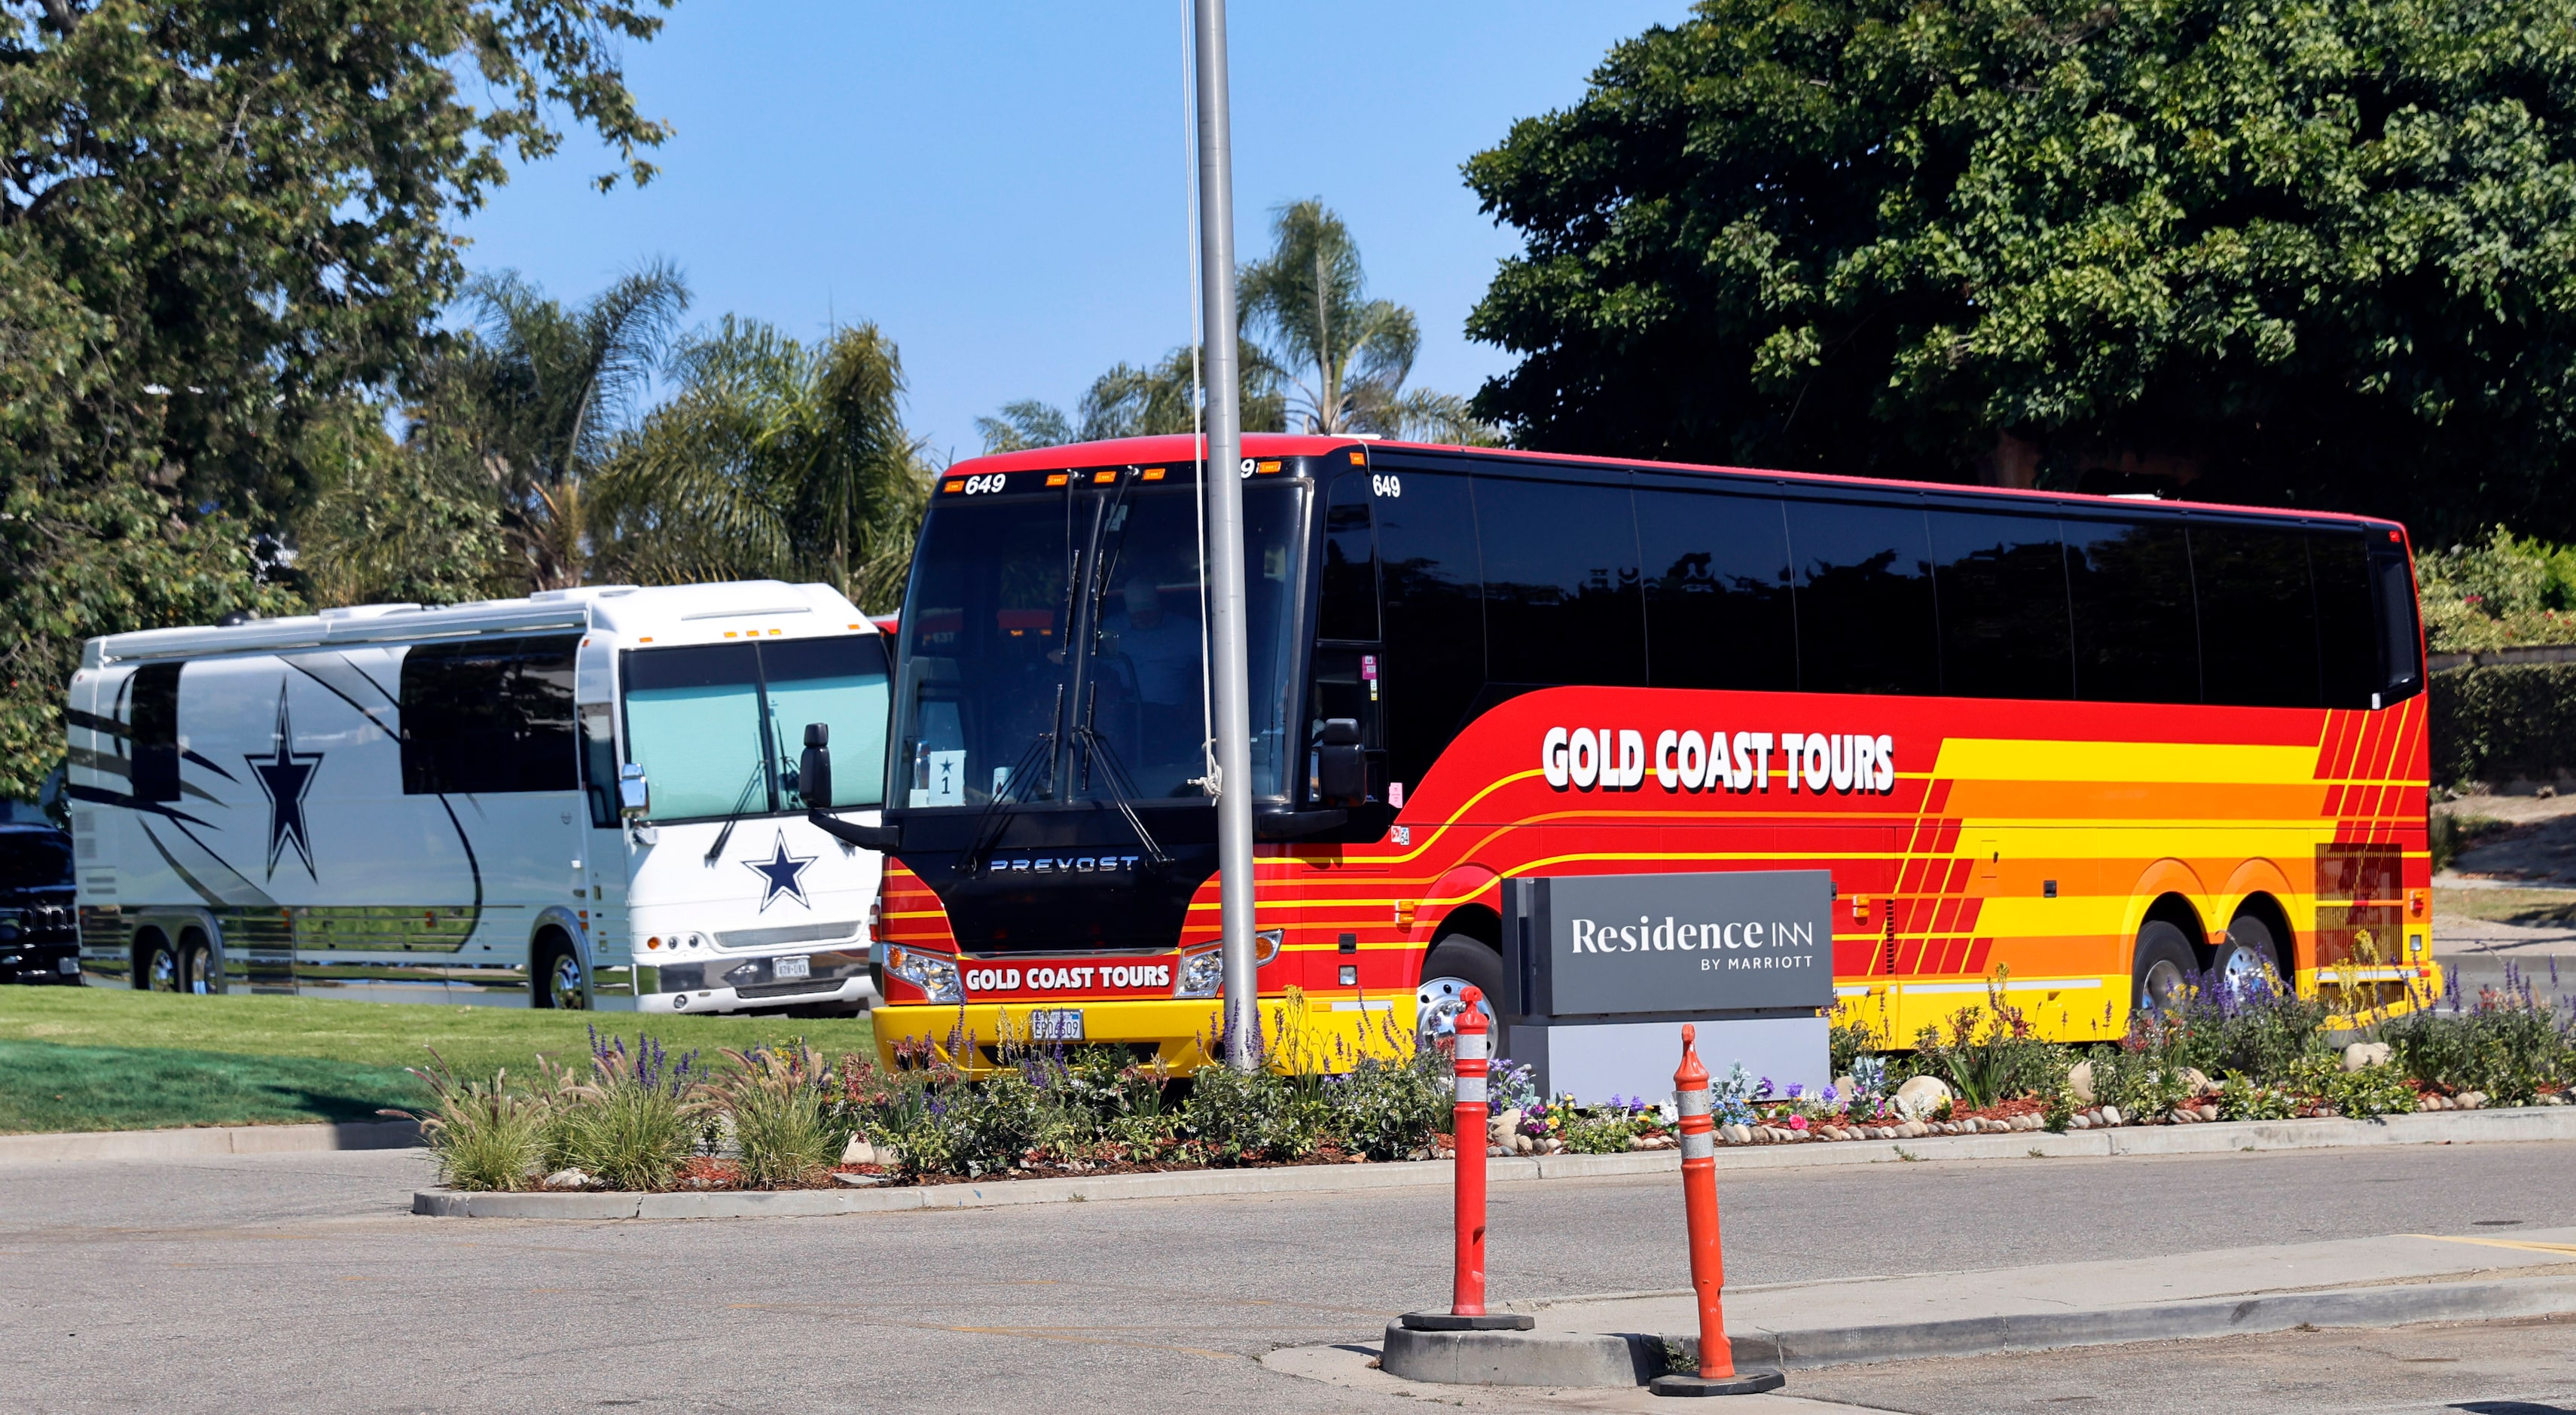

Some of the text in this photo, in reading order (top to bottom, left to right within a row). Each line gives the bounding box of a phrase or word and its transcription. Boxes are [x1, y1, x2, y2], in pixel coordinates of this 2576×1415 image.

[965, 473, 1006, 495] 649
[1372, 474, 1401, 498] 649
[1542, 726, 1895, 794] GOLD COAST TOURS
[941, 776, 951, 795] 1
[990, 855, 1140, 874] PREVOST
[1571, 915, 1813, 954] Residence INN
[1701, 955, 1813, 971] BY MARRIOTT
[966, 964, 1169, 991] GOLD COAST TOURS
